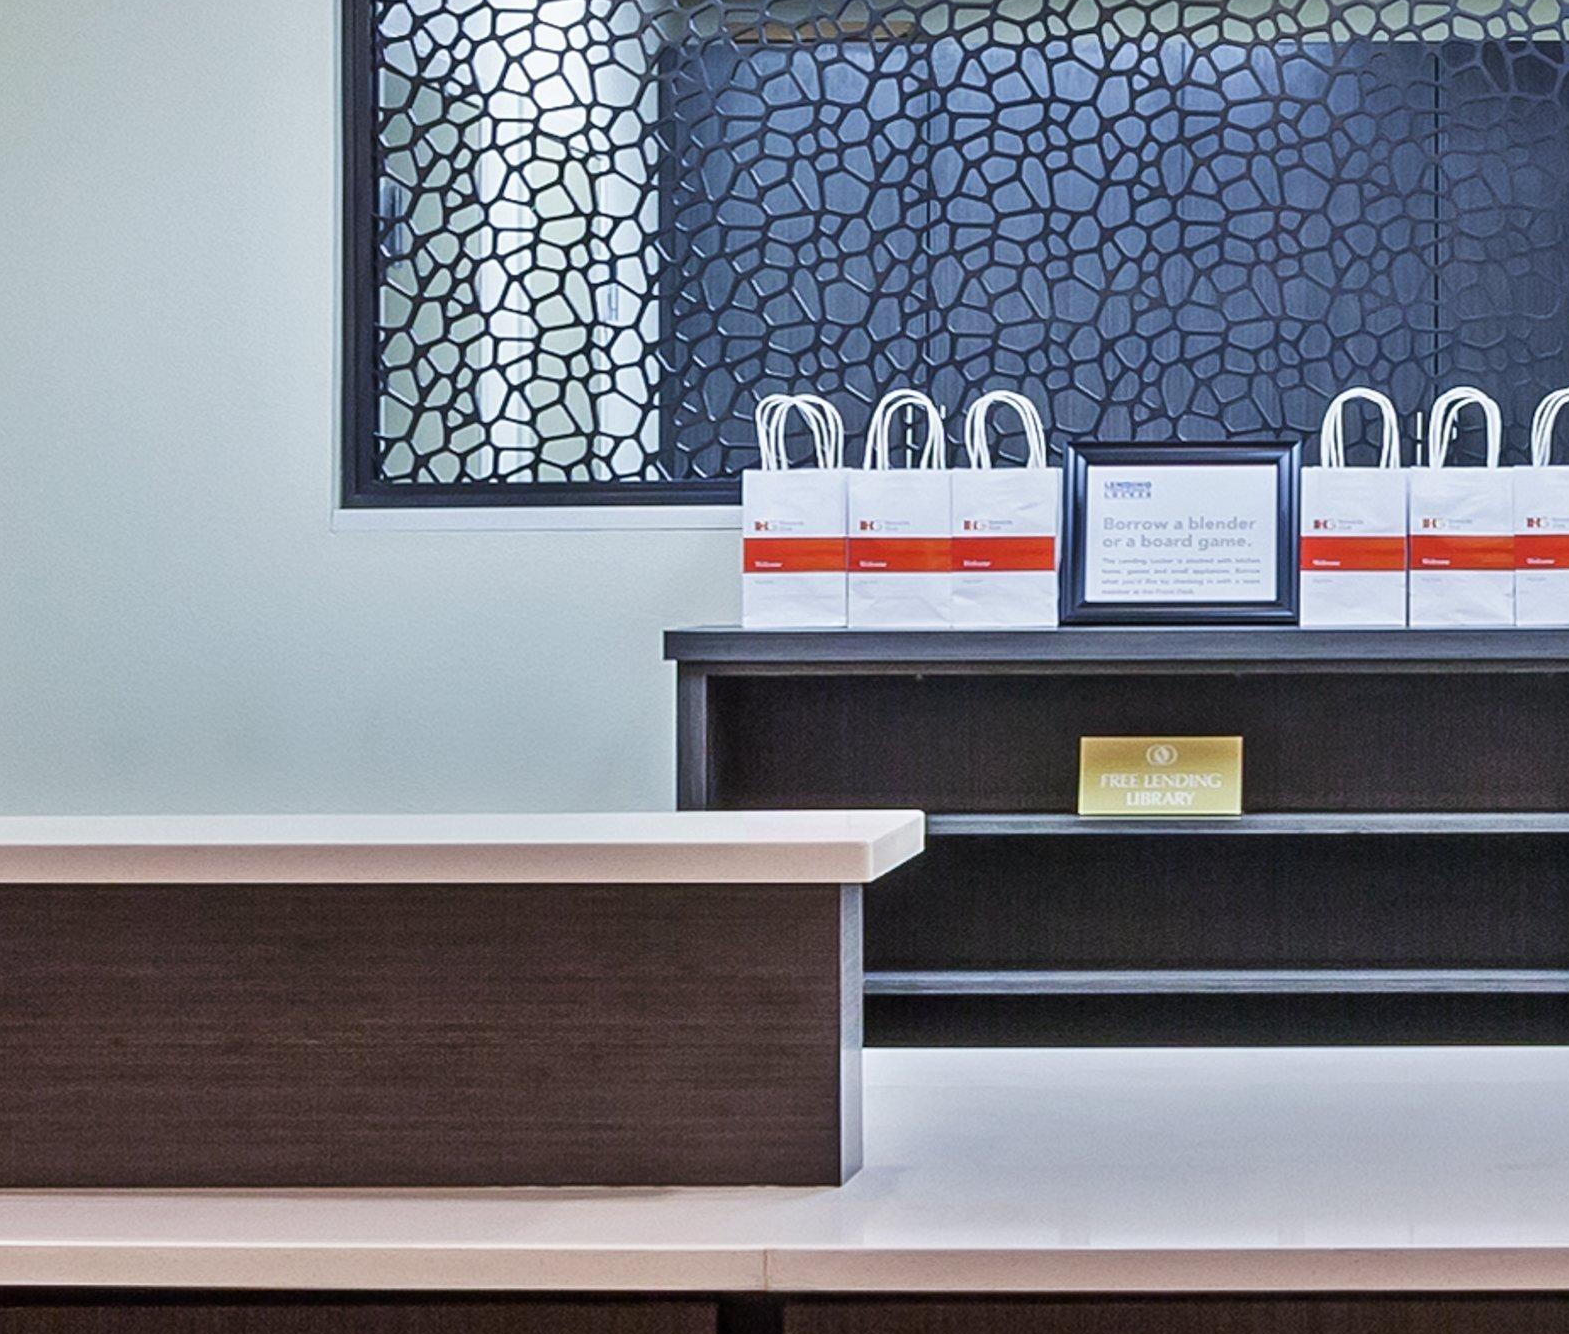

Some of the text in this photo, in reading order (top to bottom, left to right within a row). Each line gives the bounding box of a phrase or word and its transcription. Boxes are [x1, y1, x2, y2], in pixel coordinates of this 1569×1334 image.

[1103, 517, 1256, 531] Borrow a blender
[1102, 535, 1252, 551] or a board game.
[1101, 774, 1222, 788] FREE LENDING
[1126, 792, 1195, 806] LIBRARY
